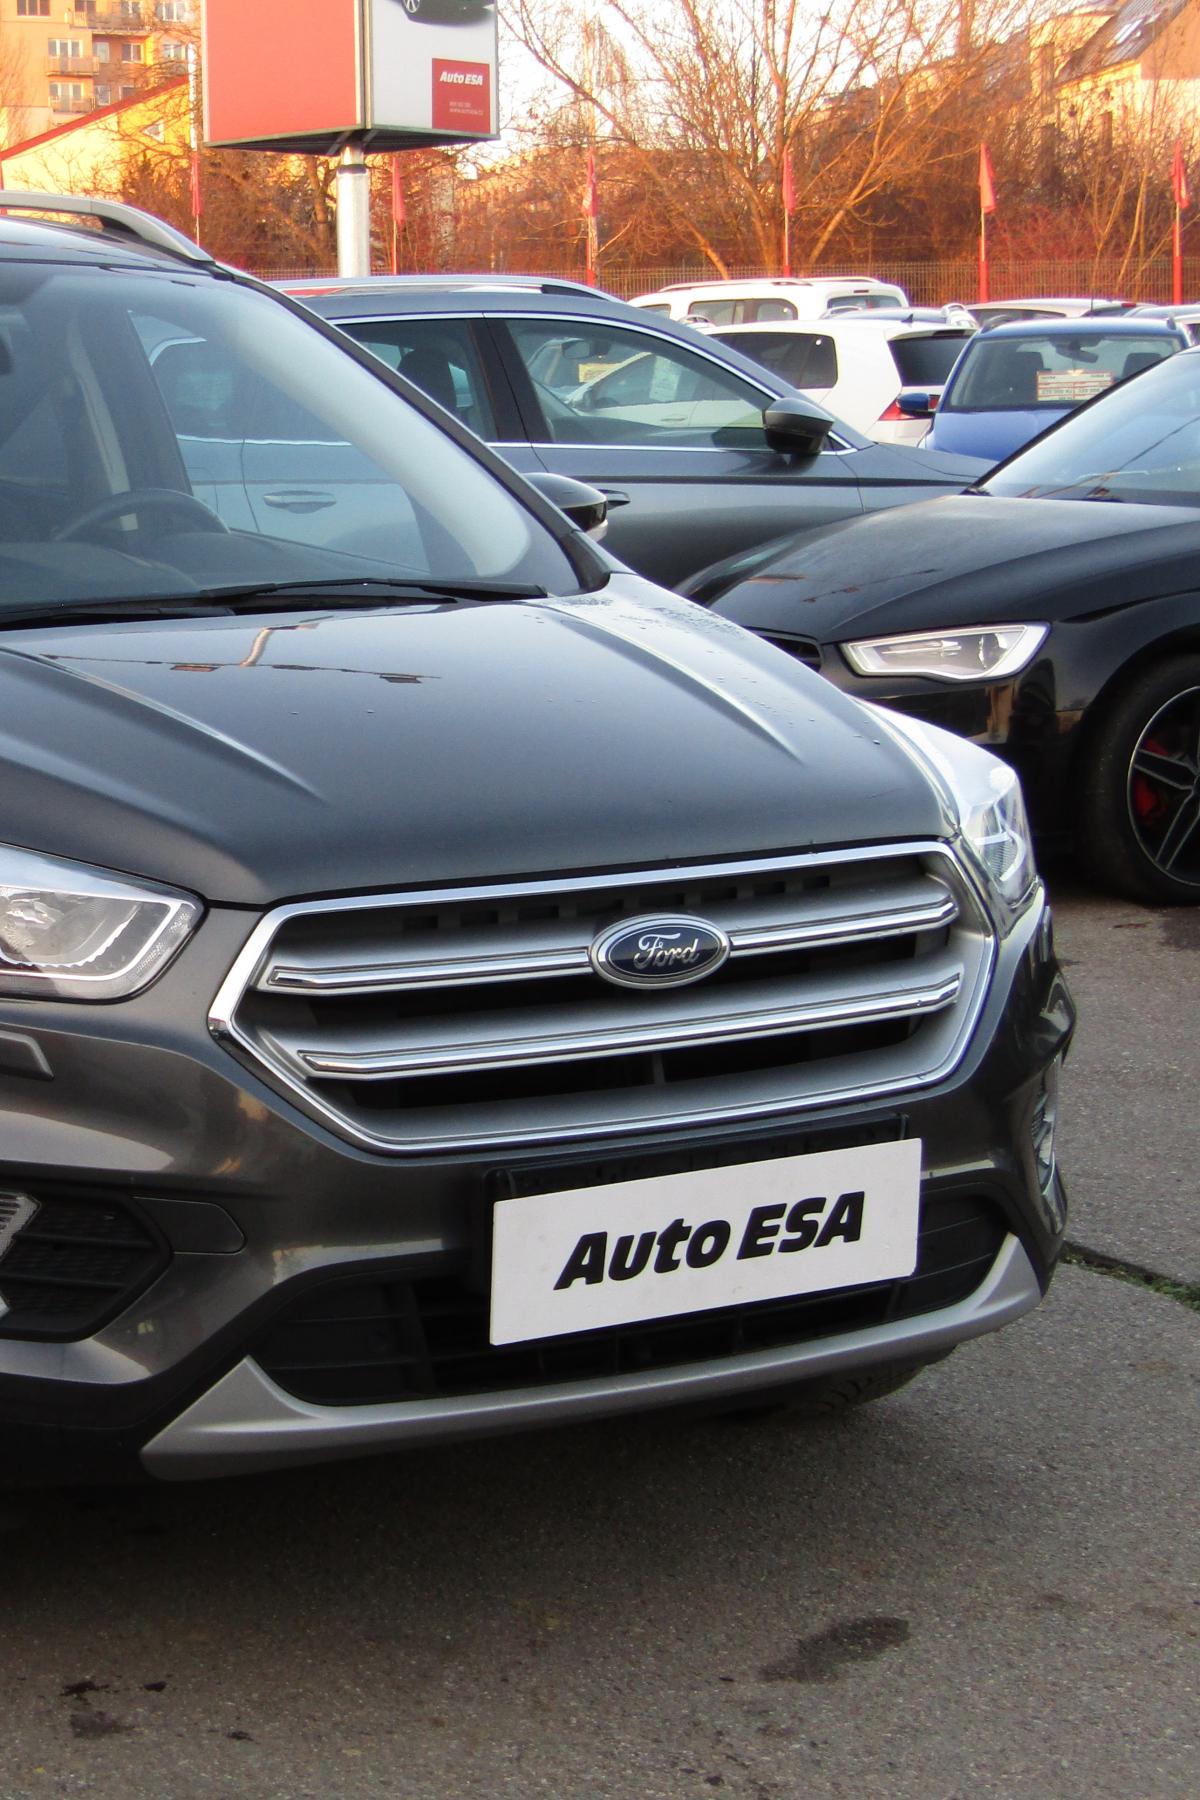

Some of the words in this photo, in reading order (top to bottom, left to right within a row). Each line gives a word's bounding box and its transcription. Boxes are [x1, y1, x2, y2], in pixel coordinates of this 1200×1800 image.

[439, 71, 464, 84] Auto
[465, 73, 483, 86] ESA
[633, 932, 700, 970] Ford
[553, 1218, 731, 1291] Auto
[736, 1190, 865, 1260] ESA
